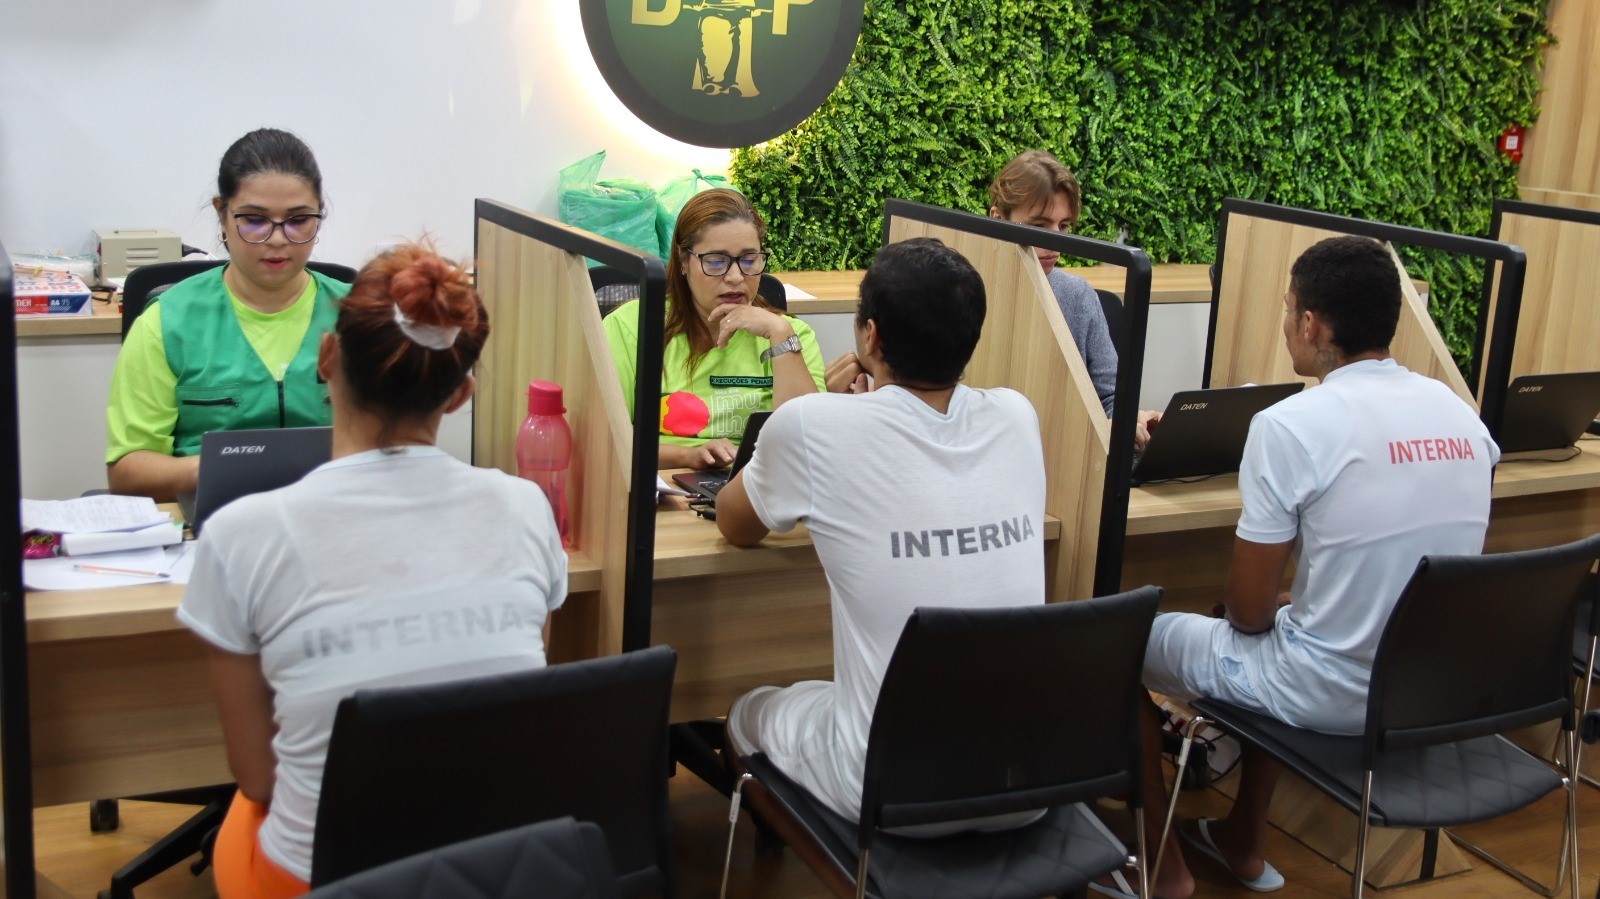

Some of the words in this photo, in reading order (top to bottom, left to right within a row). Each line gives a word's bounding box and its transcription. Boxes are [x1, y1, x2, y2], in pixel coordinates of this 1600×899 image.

[711, 377, 748, 385] EXECUÇÕES
[1519, 385, 1544, 393] DATEN
[717, 393, 761, 409] mu
[1180, 402, 1209, 411] DATEN
[717, 410, 749, 432] lh
[221, 445, 266, 455] DATEN
[1388, 437, 1475, 465] INTERNA
[890, 513, 1035, 558] INTERNA
[301, 602, 525, 659] INTERNA
